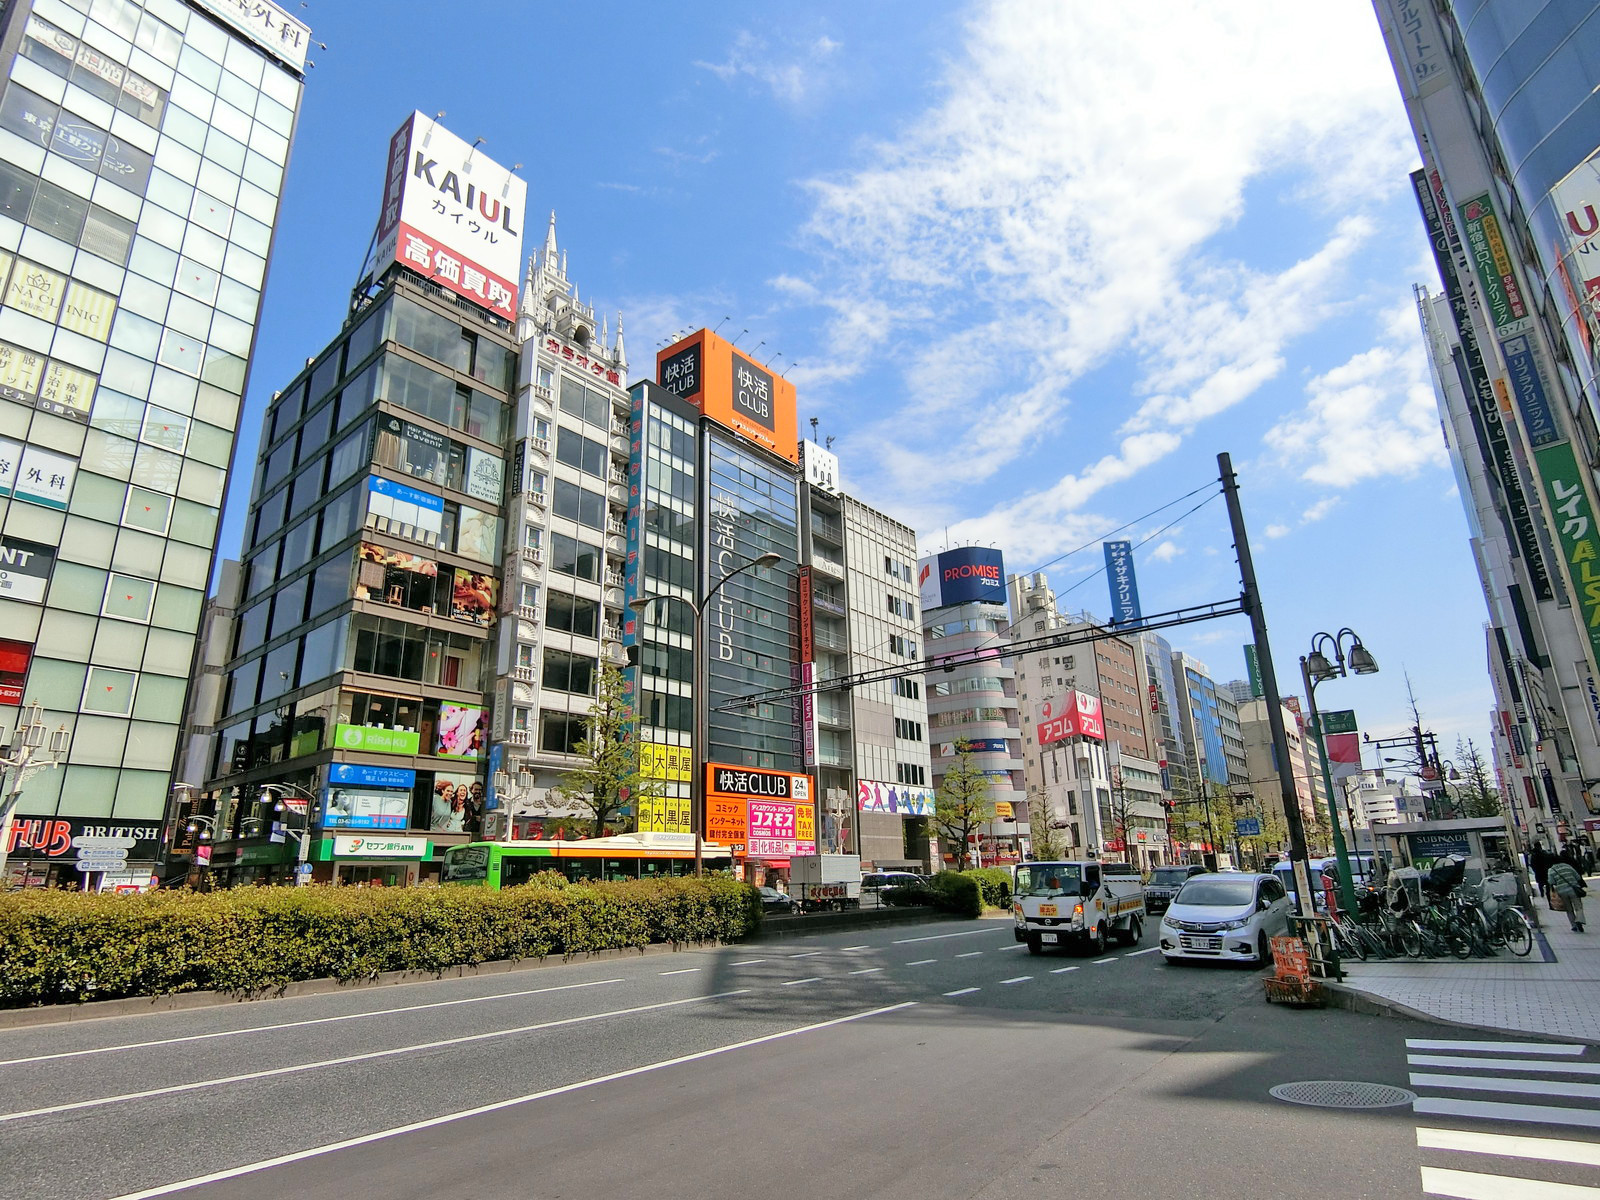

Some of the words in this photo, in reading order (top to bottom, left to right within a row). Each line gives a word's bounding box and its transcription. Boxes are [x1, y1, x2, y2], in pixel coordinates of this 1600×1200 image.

[229, 0, 302, 48] 外科
[414, 151, 518, 237] KAIUL
[431, 199, 499, 244] カイウル
[405, 232, 512, 313] 高価買取
[1467, 221, 1507, 326] 新宿東口ハートクリニック
[546, 339, 620, 388] カラオケ館
[664, 353, 695, 384] 快活
[665, 374, 695, 396] CLUB
[737, 366, 769, 402] 快活
[738, 390, 769, 419] CLUB
[1519, 506, 1526, 514] 5
[1552, 479, 1588, 540] レイク
[716, 492, 736, 662] 快活CLUB
[944, 564, 999, 582] PROMISE
[980, 577, 1000, 587] プロミス
[1114, 557, 1134, 626] オザキクリニック
[1043, 717, 1073, 740] アコム
[1082, 715, 1101, 736] アコム
[655, 753, 691, 772] 大黒屋
[720, 770, 787, 797] 快活CLUB
[653, 809, 690, 826] 大黒屋
[715, 804, 739, 813] コミック
[752, 811, 794, 827] コスモス
[797, 807, 813, 819] 免税
[709, 816, 745, 826] インターネット
[798, 820, 812, 830] TAX
[8, 819, 72, 857] HUB
[83, 825, 159, 840] BRITISH
[798, 830, 813, 838] FREE
[366, 842, 401, 851] セブン銀行
[761, 841, 782, 854] 化粧品
